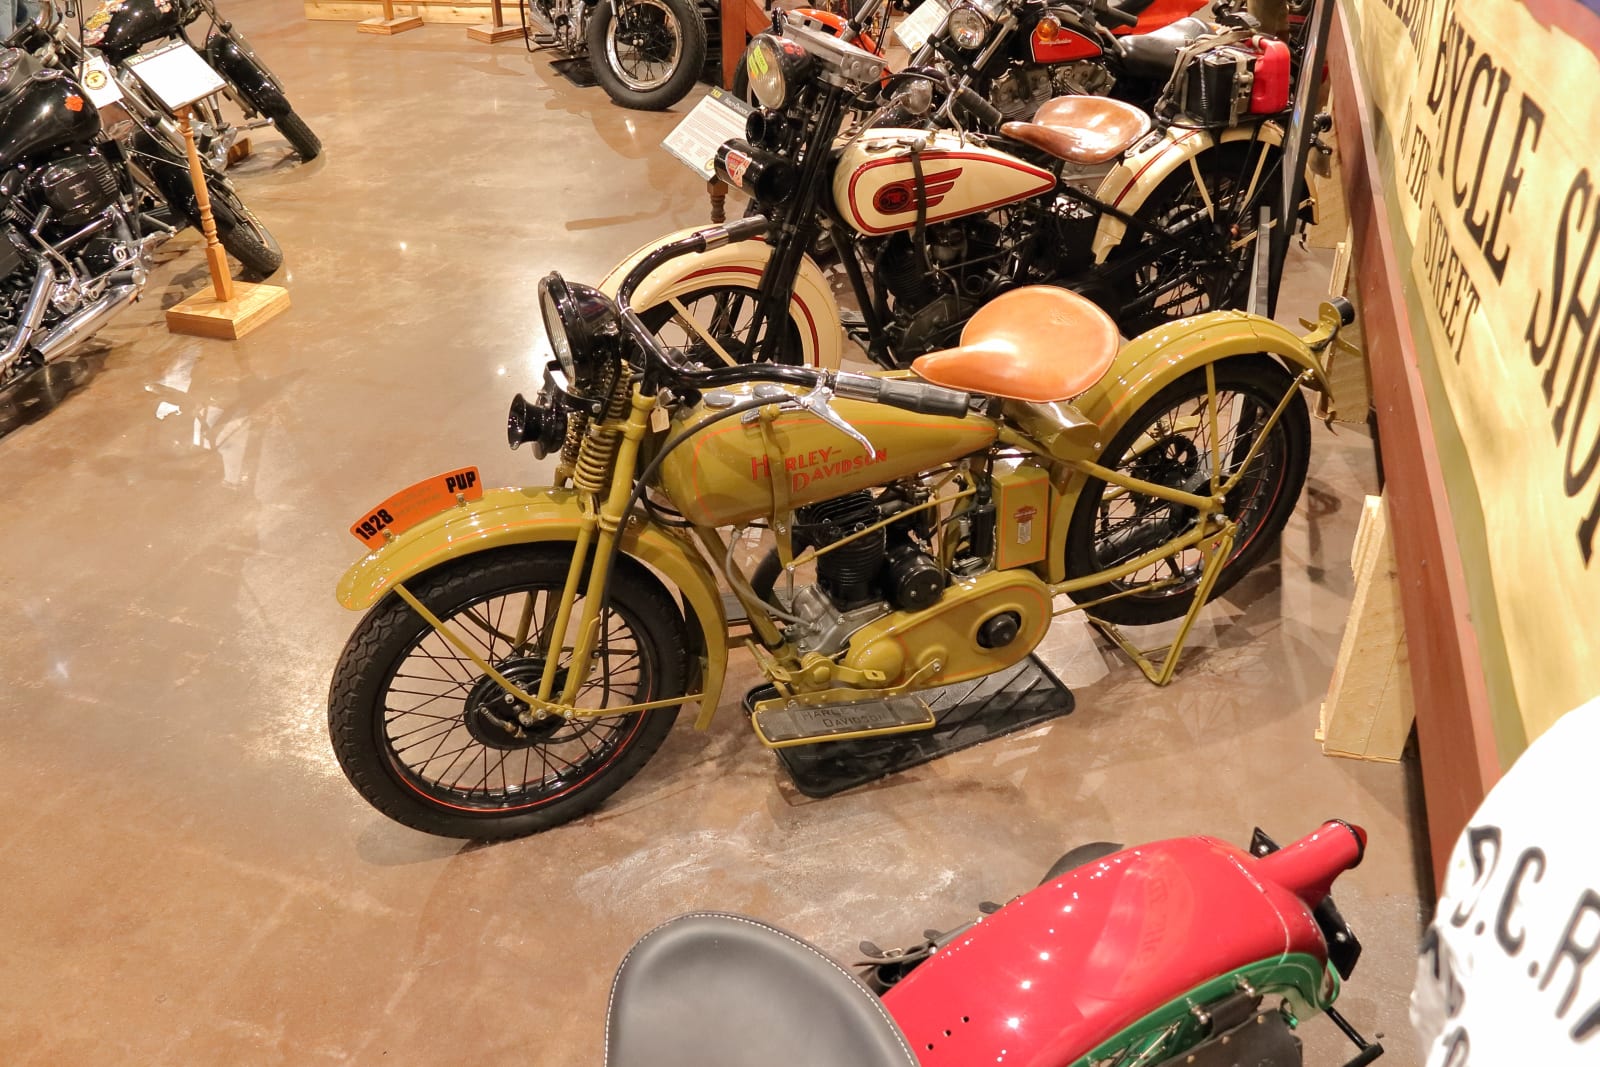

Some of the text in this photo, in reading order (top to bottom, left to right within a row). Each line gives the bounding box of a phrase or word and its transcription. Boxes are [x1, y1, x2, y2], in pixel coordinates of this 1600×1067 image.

[1424, 200, 1481, 365] STREET
[751, 446, 842, 480] HRLEY-
[445, 471, 477, 493] PUP
[355, 509, 395, 540] 1928
